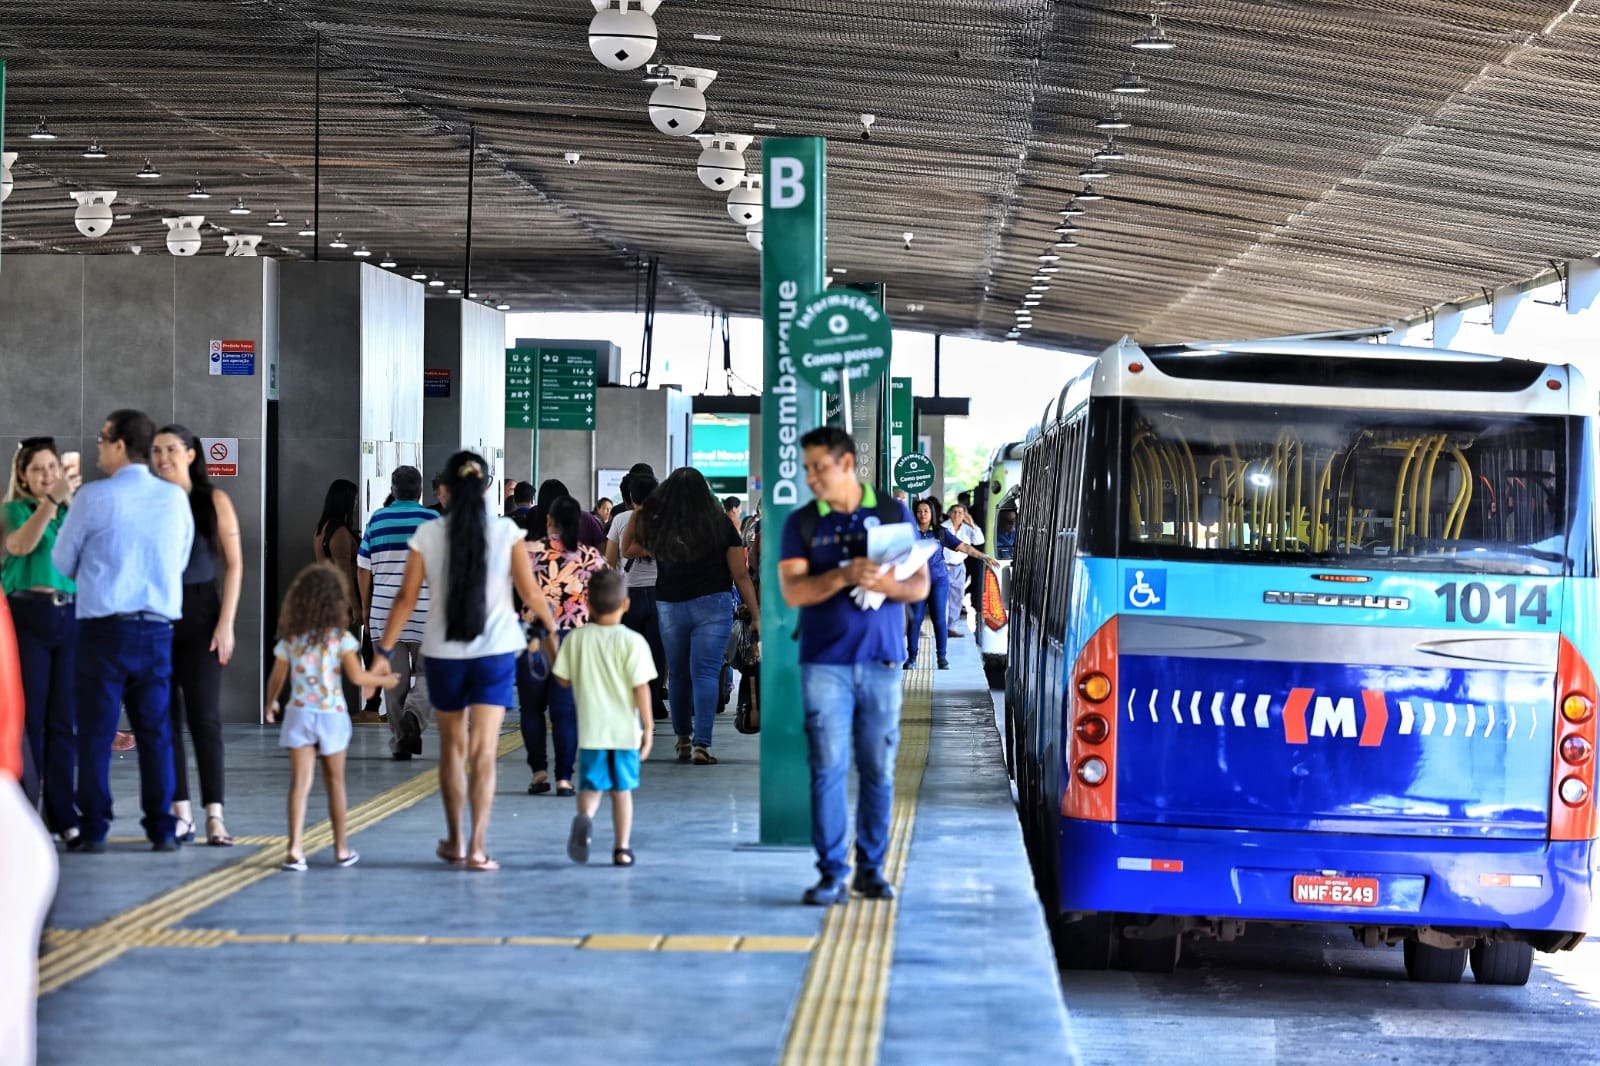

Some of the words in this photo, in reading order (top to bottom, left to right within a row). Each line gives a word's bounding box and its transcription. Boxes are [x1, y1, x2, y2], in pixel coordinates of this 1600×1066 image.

[769, 157, 806, 209] B
[796, 294, 880, 329] Informações
[802, 352, 843, 368] Como
[844, 346, 884, 365] posso
[772, 279, 798, 505] Desembarque
[1434, 581, 1553, 625] 1014
[1310, 696, 1357, 738] M
